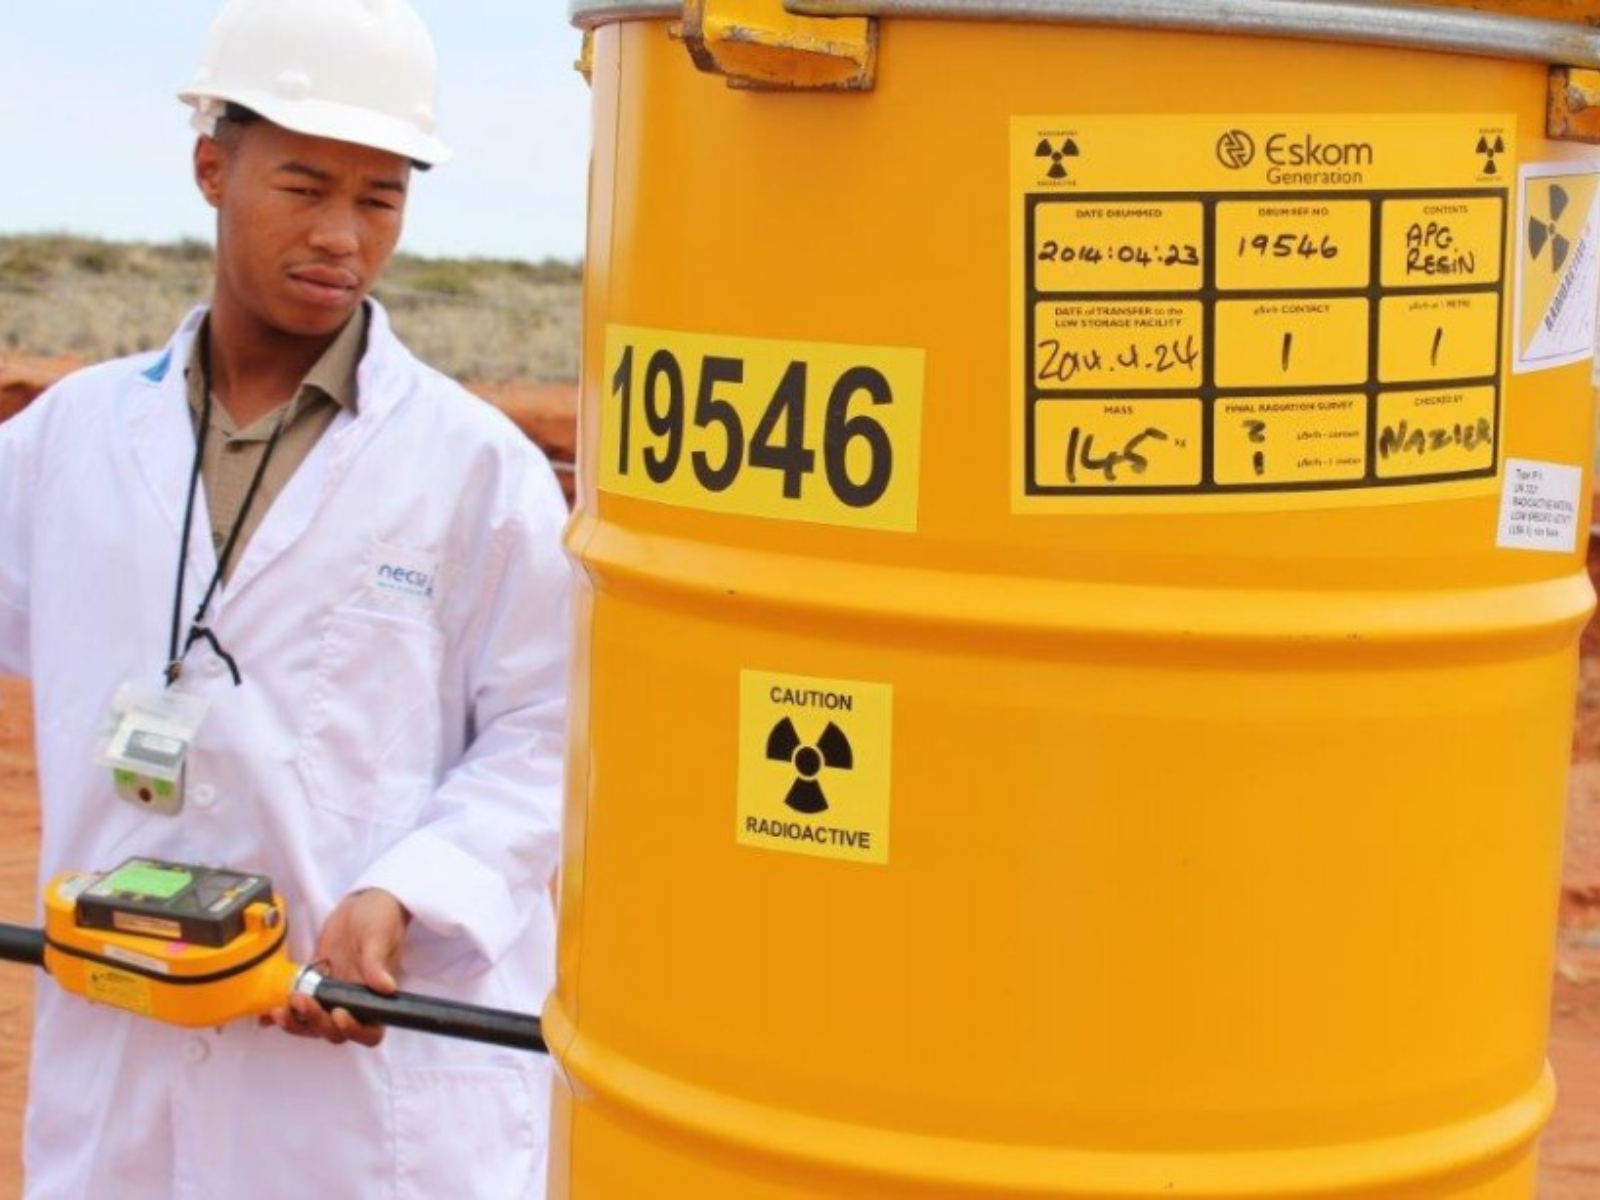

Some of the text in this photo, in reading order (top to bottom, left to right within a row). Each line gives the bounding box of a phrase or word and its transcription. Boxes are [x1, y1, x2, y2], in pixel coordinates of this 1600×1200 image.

[1265, 132, 1373, 166] Eskom
[1266, 167, 1363, 185] Generation
[1076, 208, 1162, 218] DATE DRUMMED
[1423, 205, 1469, 215] CONTENTS
[1238, 234, 1338, 259] 19546
[1055, 307, 1082, 316] DATE
[1097, 306, 1152, 316] TRANSFER
[1282, 304, 1330, 314] CONTACT
[1080, 318, 1130, 328] STORAGE
[1134, 318, 1182, 328] FACILITY
[1104, 406, 1134, 415] MASS
[1225, 400, 1354, 414] FINAL RADIATION SURVEY
[611, 344, 893, 507] 19546
[1066, 426, 1168, 483] 145
[769, 686, 853, 711] CAUTION
[745, 816, 871, 849] RADIOACTIVE
